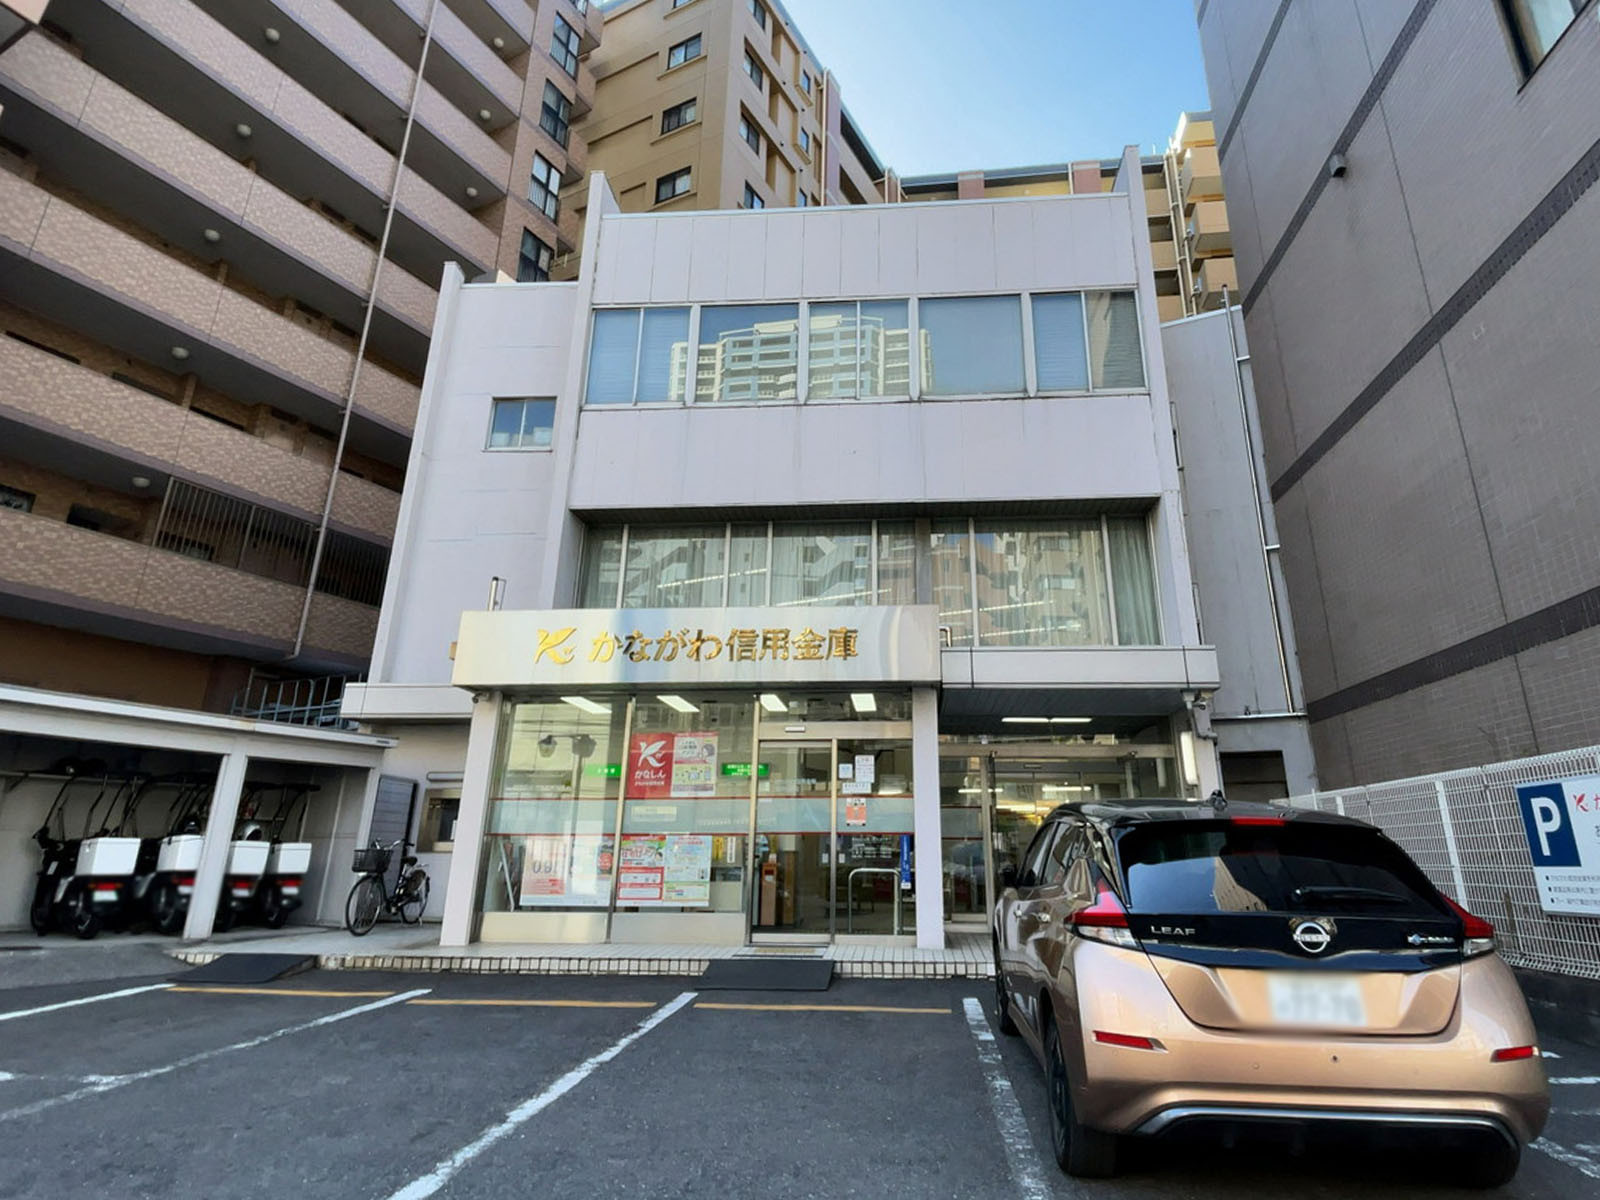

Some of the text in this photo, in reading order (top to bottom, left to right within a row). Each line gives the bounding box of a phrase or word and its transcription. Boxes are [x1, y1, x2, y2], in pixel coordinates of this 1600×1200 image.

[588, 626, 859, 662] かながわ信用金庫
[634, 769, 667, 779] かなしん
[1530, 796, 1561, 856] P
[1150, 925, 1196, 937] LEAF
